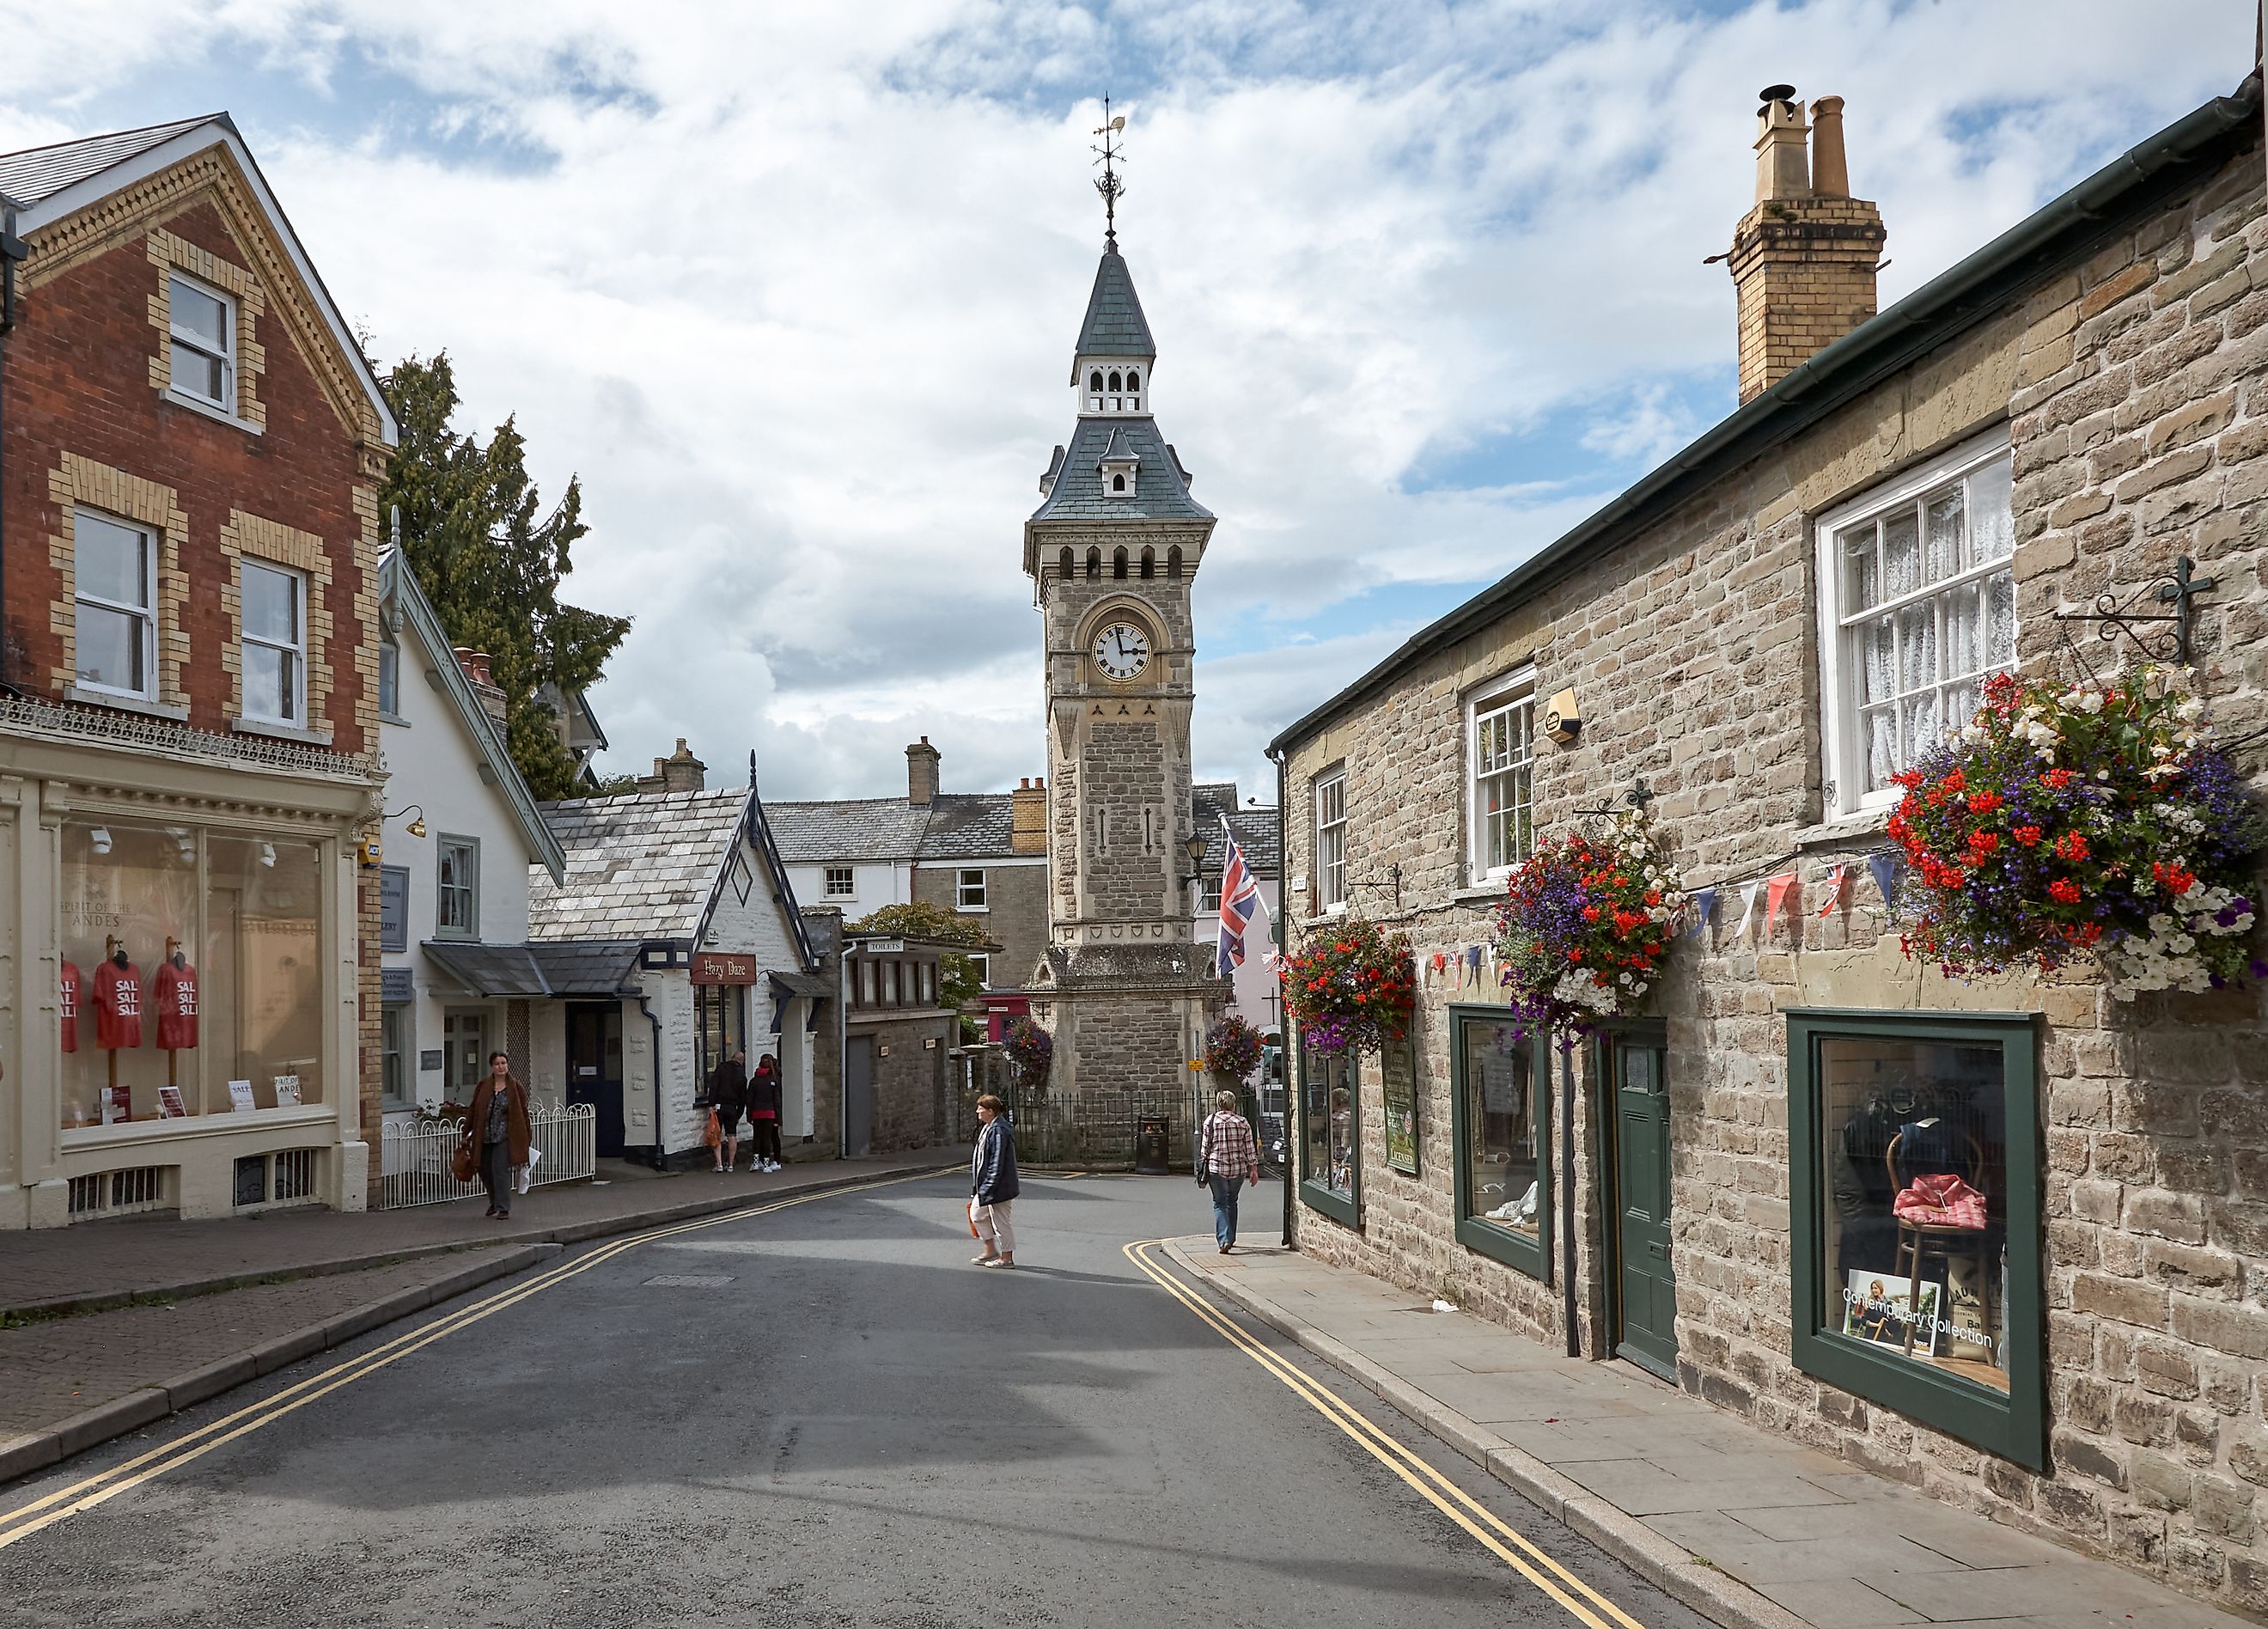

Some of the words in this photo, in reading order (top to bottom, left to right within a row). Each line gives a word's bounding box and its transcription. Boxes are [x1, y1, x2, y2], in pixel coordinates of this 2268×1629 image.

[95, 902, 109, 912] OF
[113, 903, 131, 912] THE
[72, 915, 119, 927] ANDES
[704, 958, 724, 980] Hazy
[728, 959, 746, 976] Daze
[116, 980, 137, 992] SAL
[177, 981, 196, 992] SAL
[117, 992, 138, 1004] SAL
[179, 993, 197, 1004] SAL
[119, 1004, 140, 1016] SAL
[1927, 1315, 1992, 1349] Collection
